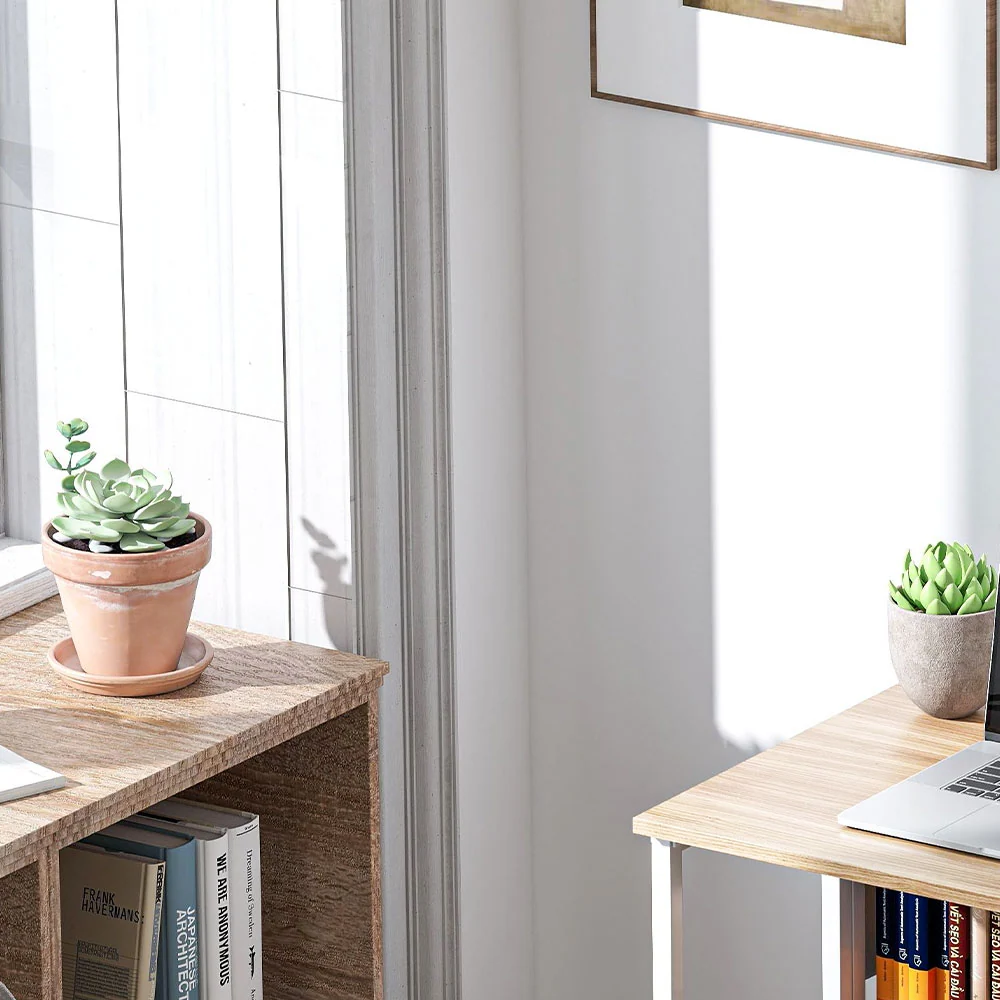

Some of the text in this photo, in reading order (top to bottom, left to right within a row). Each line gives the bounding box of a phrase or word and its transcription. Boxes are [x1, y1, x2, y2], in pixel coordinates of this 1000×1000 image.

[83, 887, 115, 906] FRANK
[216, 853, 230, 986] WE ARE ANONYMOUS
[949, 905, 964, 925] VẾT
[187, 906, 197, 991] JAPANESE
[950, 946, 964, 959] VÀ
[950, 960, 962, 978] CÁI
[950, 978, 964, 1000] ĐẦU
